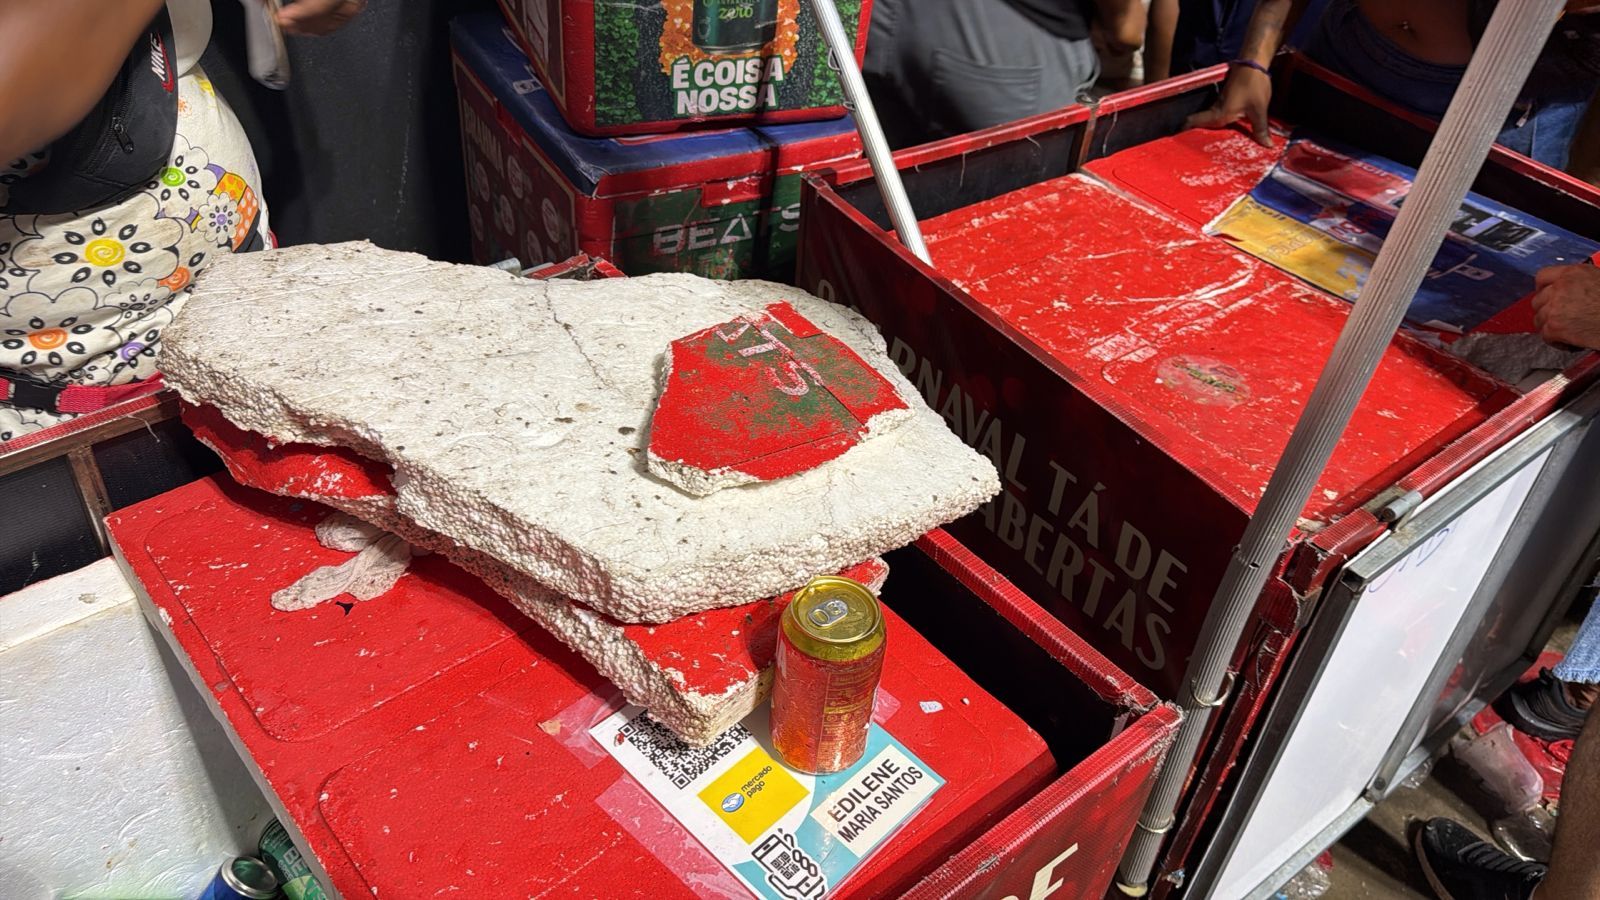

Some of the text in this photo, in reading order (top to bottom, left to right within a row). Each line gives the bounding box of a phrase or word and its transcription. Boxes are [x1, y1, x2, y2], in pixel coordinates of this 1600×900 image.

[150, 33, 166, 82] NIKE
[673, 57, 784, 89] É COISA
[677, 84, 778, 115] NOSSA
[872, 325, 1026, 492] RNAVAL
[1048, 460, 1107, 549] TÁ
[1114, 520, 1188, 613] DE
[740, 764, 773, 794] mercado
[746, 779, 766, 799] pago
[831, 758, 900, 823] EDILENE
[840, 766, 924, 843] MARIA SANTOS
